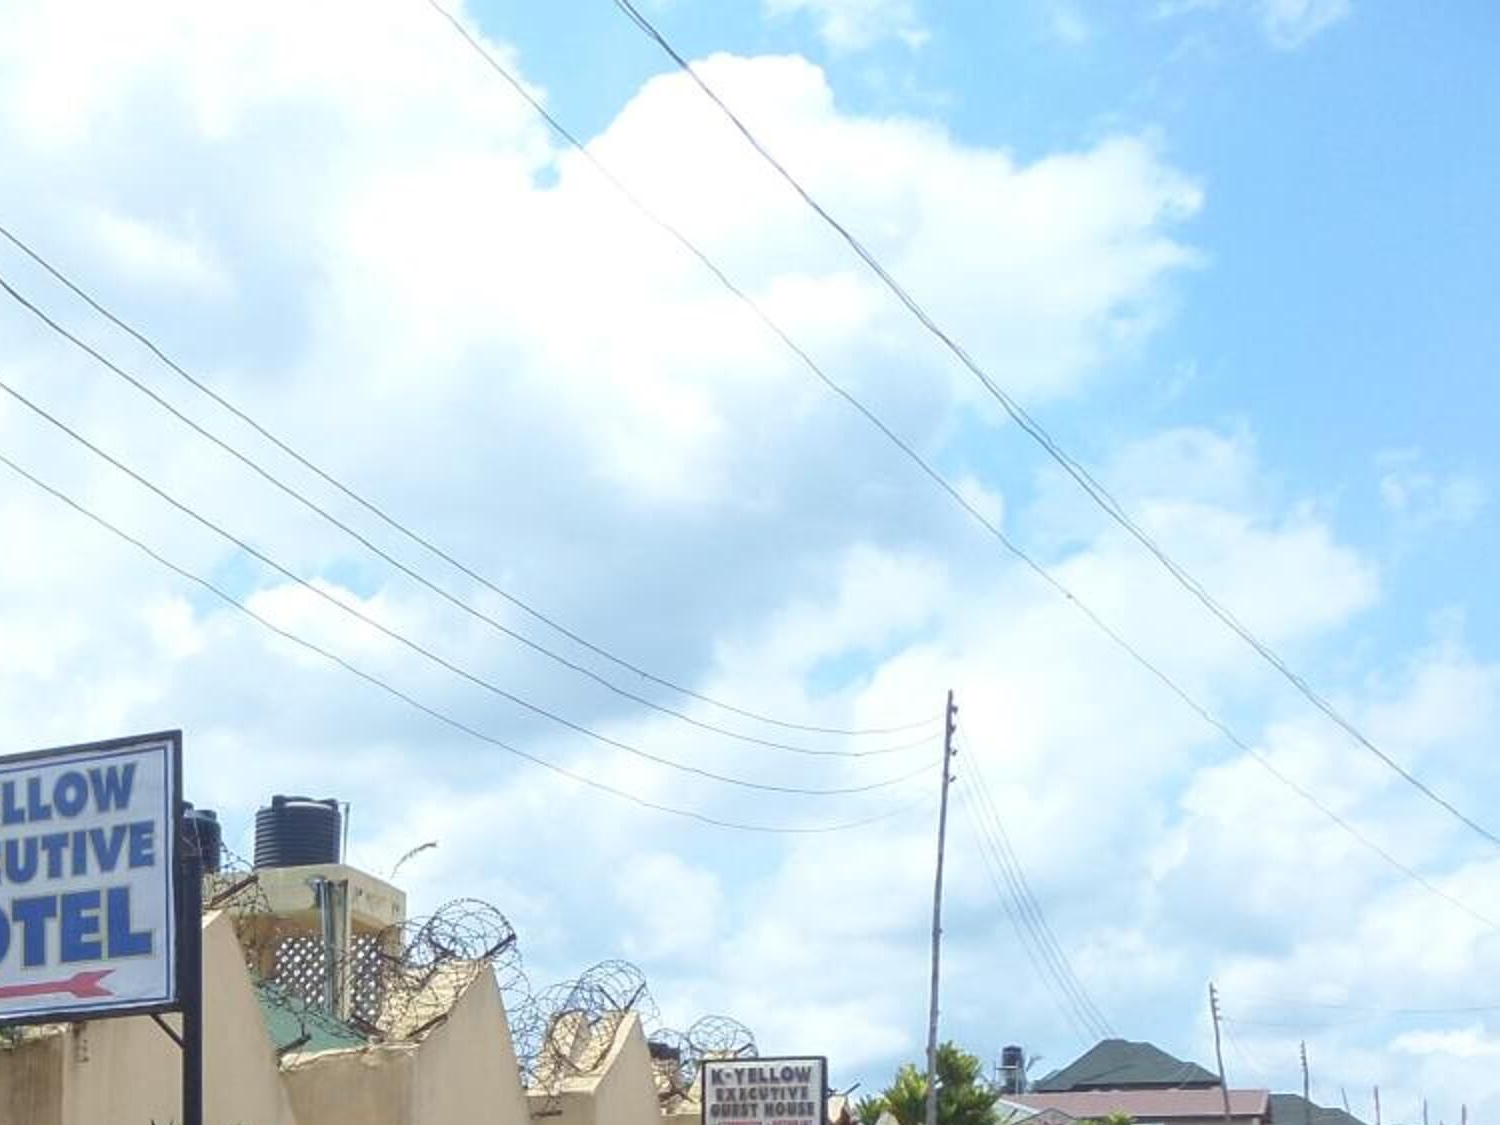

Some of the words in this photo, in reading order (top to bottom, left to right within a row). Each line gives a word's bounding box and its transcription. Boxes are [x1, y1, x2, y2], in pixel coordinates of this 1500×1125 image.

[711, 1066, 811, 1085] K-YELLOW
[716, 1086, 808, 1102] EXECUTIVE
[764, 1102, 815, 1117] HOUSE
